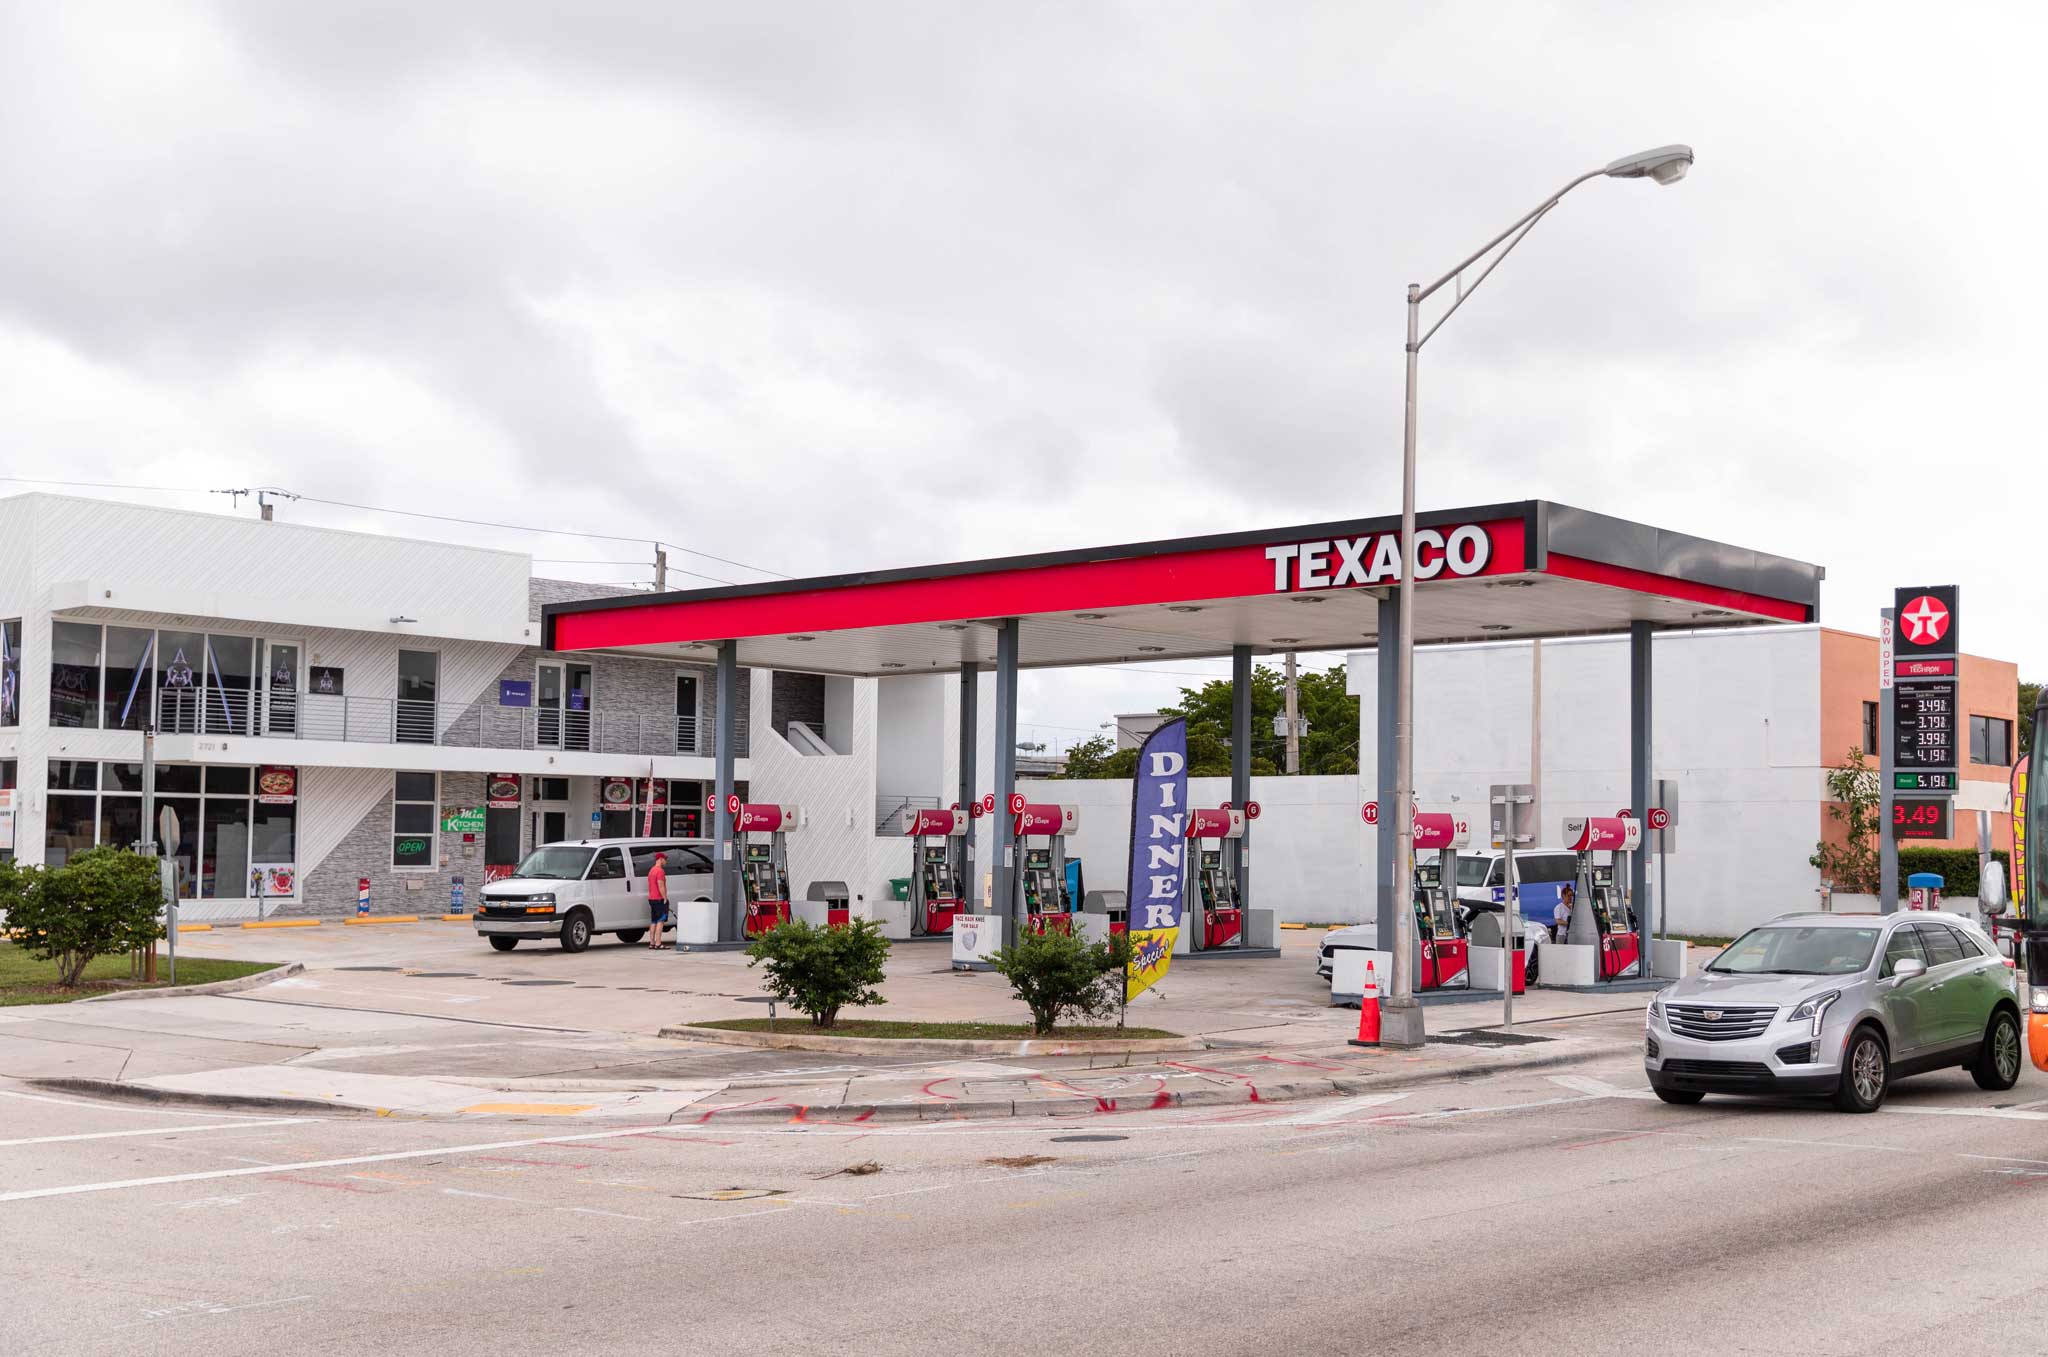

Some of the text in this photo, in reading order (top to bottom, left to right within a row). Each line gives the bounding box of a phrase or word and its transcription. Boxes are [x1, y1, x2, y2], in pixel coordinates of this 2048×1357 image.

[1265, 524, 1490, 592] TEXACO
[1883, 618, 1891, 687] NOW OPEN
[986, 800, 992, 808] 7
[1015, 799, 1022, 808] 8
[785, 811, 792, 820] 4
[1066, 811, 1073, 820] 8
[1365, 808, 1377, 818] 11
[1655, 813, 1667, 823] 10
[1893, 805, 1939, 824] 3.49
[957, 816, 963, 825] 2
[1233, 815, 1240, 825] 6
[1455, 822, 1467, 833] 12
[1567, 823, 1582, 832] Self
[1626, 826, 1637, 836] 10
[1144, 751, 1184, 929] DINNER
[398, 842, 422, 852] OPEN
